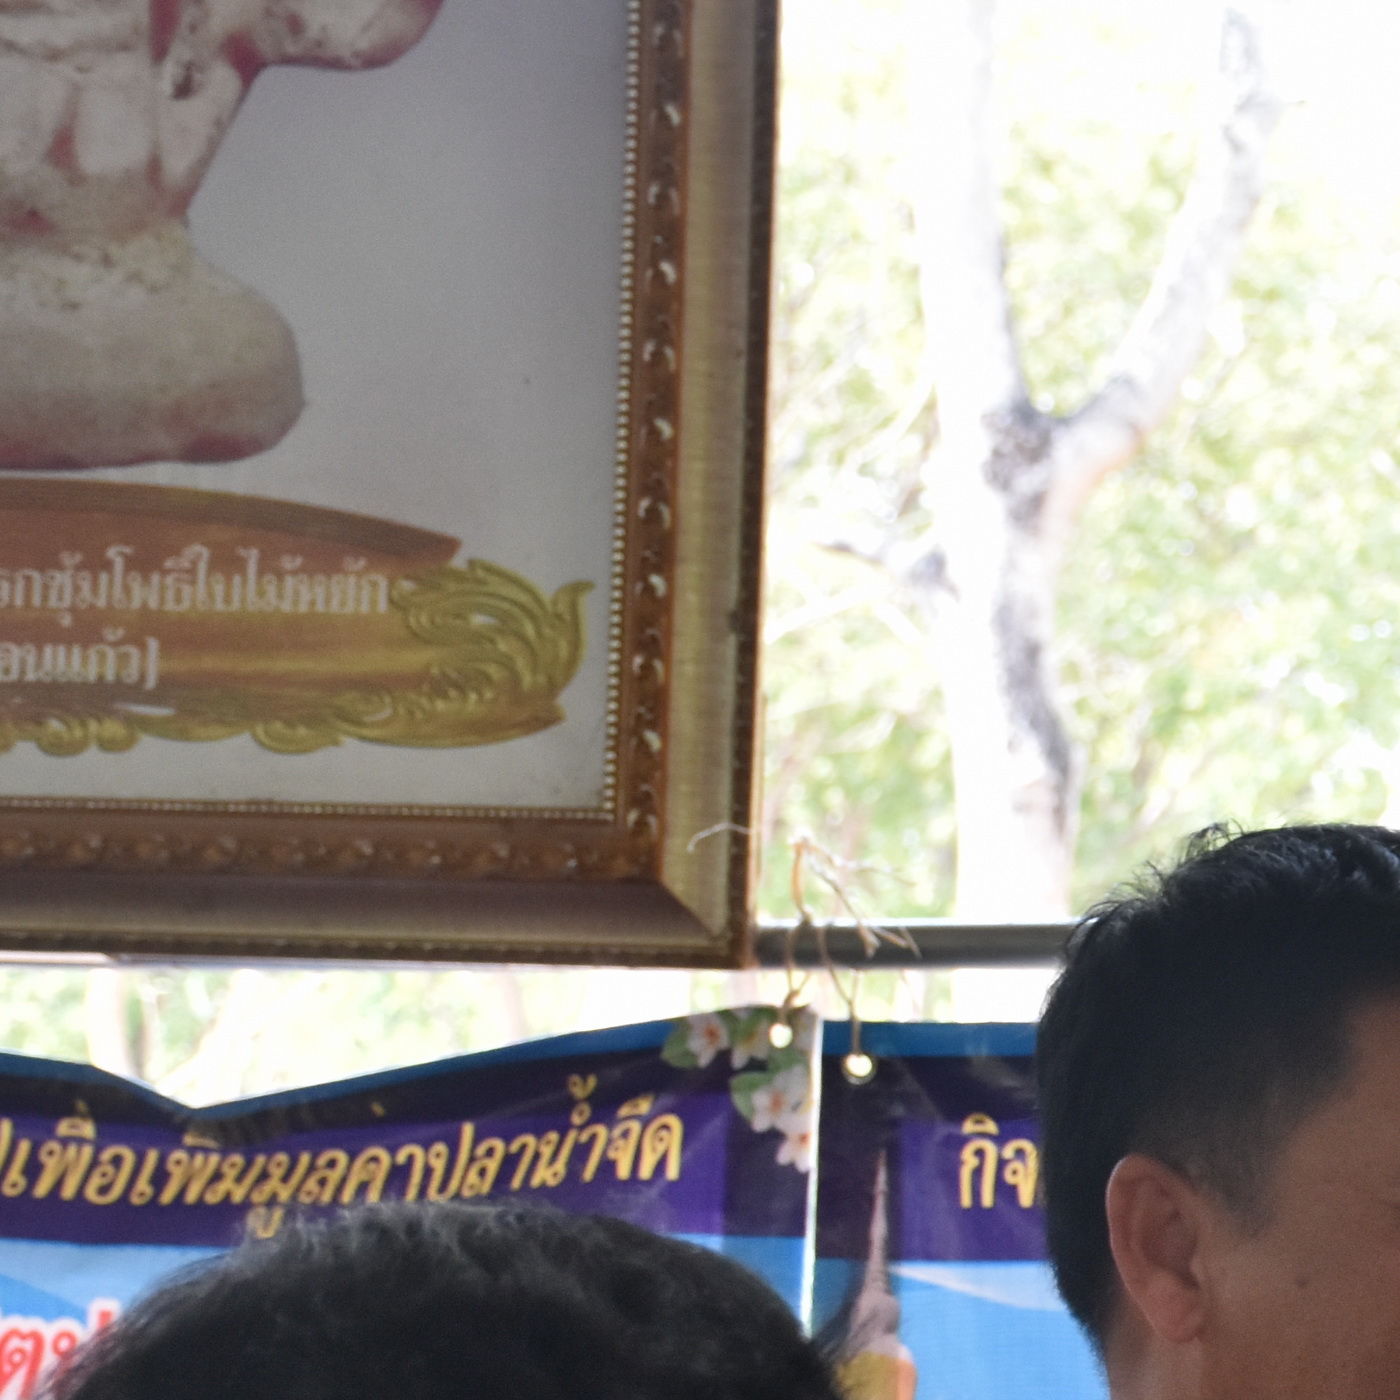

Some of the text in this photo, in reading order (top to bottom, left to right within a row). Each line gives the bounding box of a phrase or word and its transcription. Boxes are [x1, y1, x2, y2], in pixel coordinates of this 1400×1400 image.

[0, 1073, 684, 1239] เพื่อเพิมมูลค่าปลาน้ำจืด
[960, 1112, 1039, 1209] กิจ
